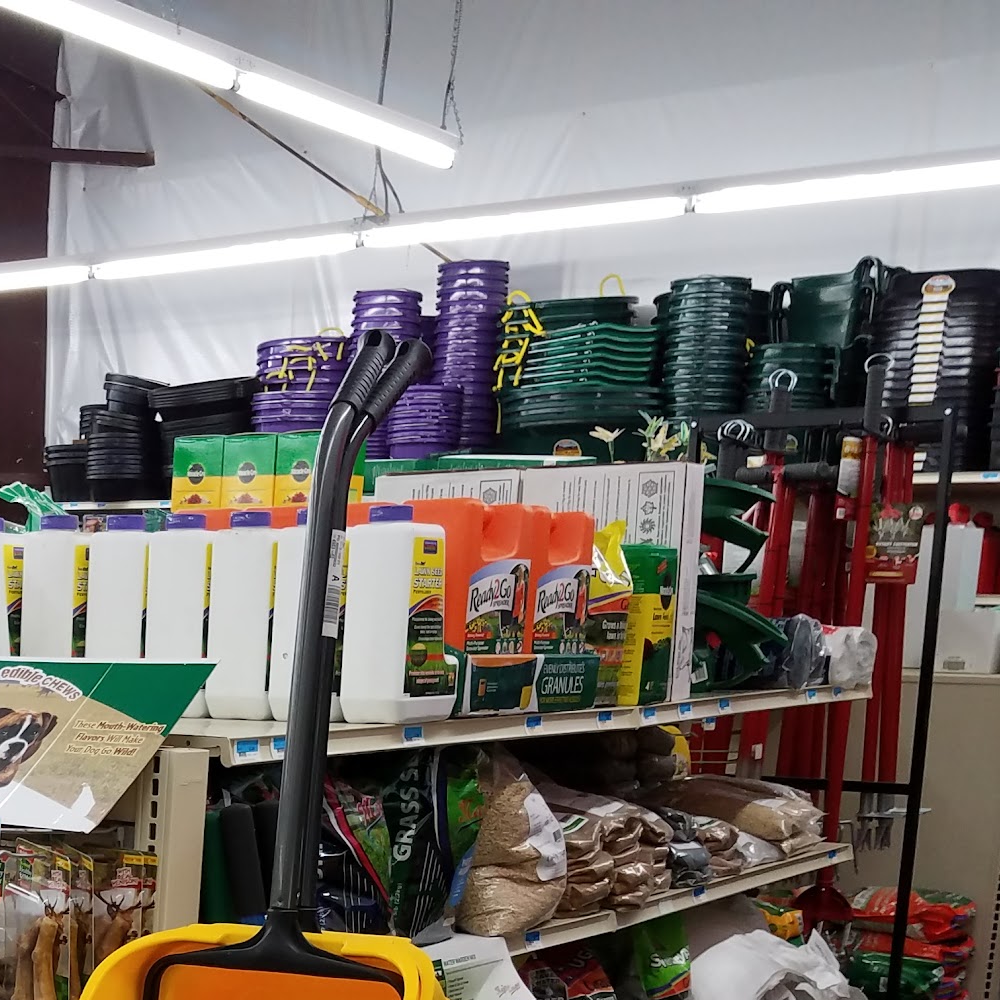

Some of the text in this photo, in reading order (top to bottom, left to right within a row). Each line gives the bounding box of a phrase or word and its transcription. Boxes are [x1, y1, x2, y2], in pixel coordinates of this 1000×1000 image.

[414, 568, 431, 576] LAWN
[470, 576, 512, 612] Ready2Go
[538, 582, 575, 613] Ready2Go
[1, 667, 82, 701] edible CHEWS
[541, 676, 584, 695] GRANULES
[74, 721, 164, 732] These Mouth-Watering
[76, 733, 104, 741] Flavors
[84, 746, 100, 755] Dog
[114, 748, 137, 756] Wild!
[393, 786, 420, 862] GRASS
